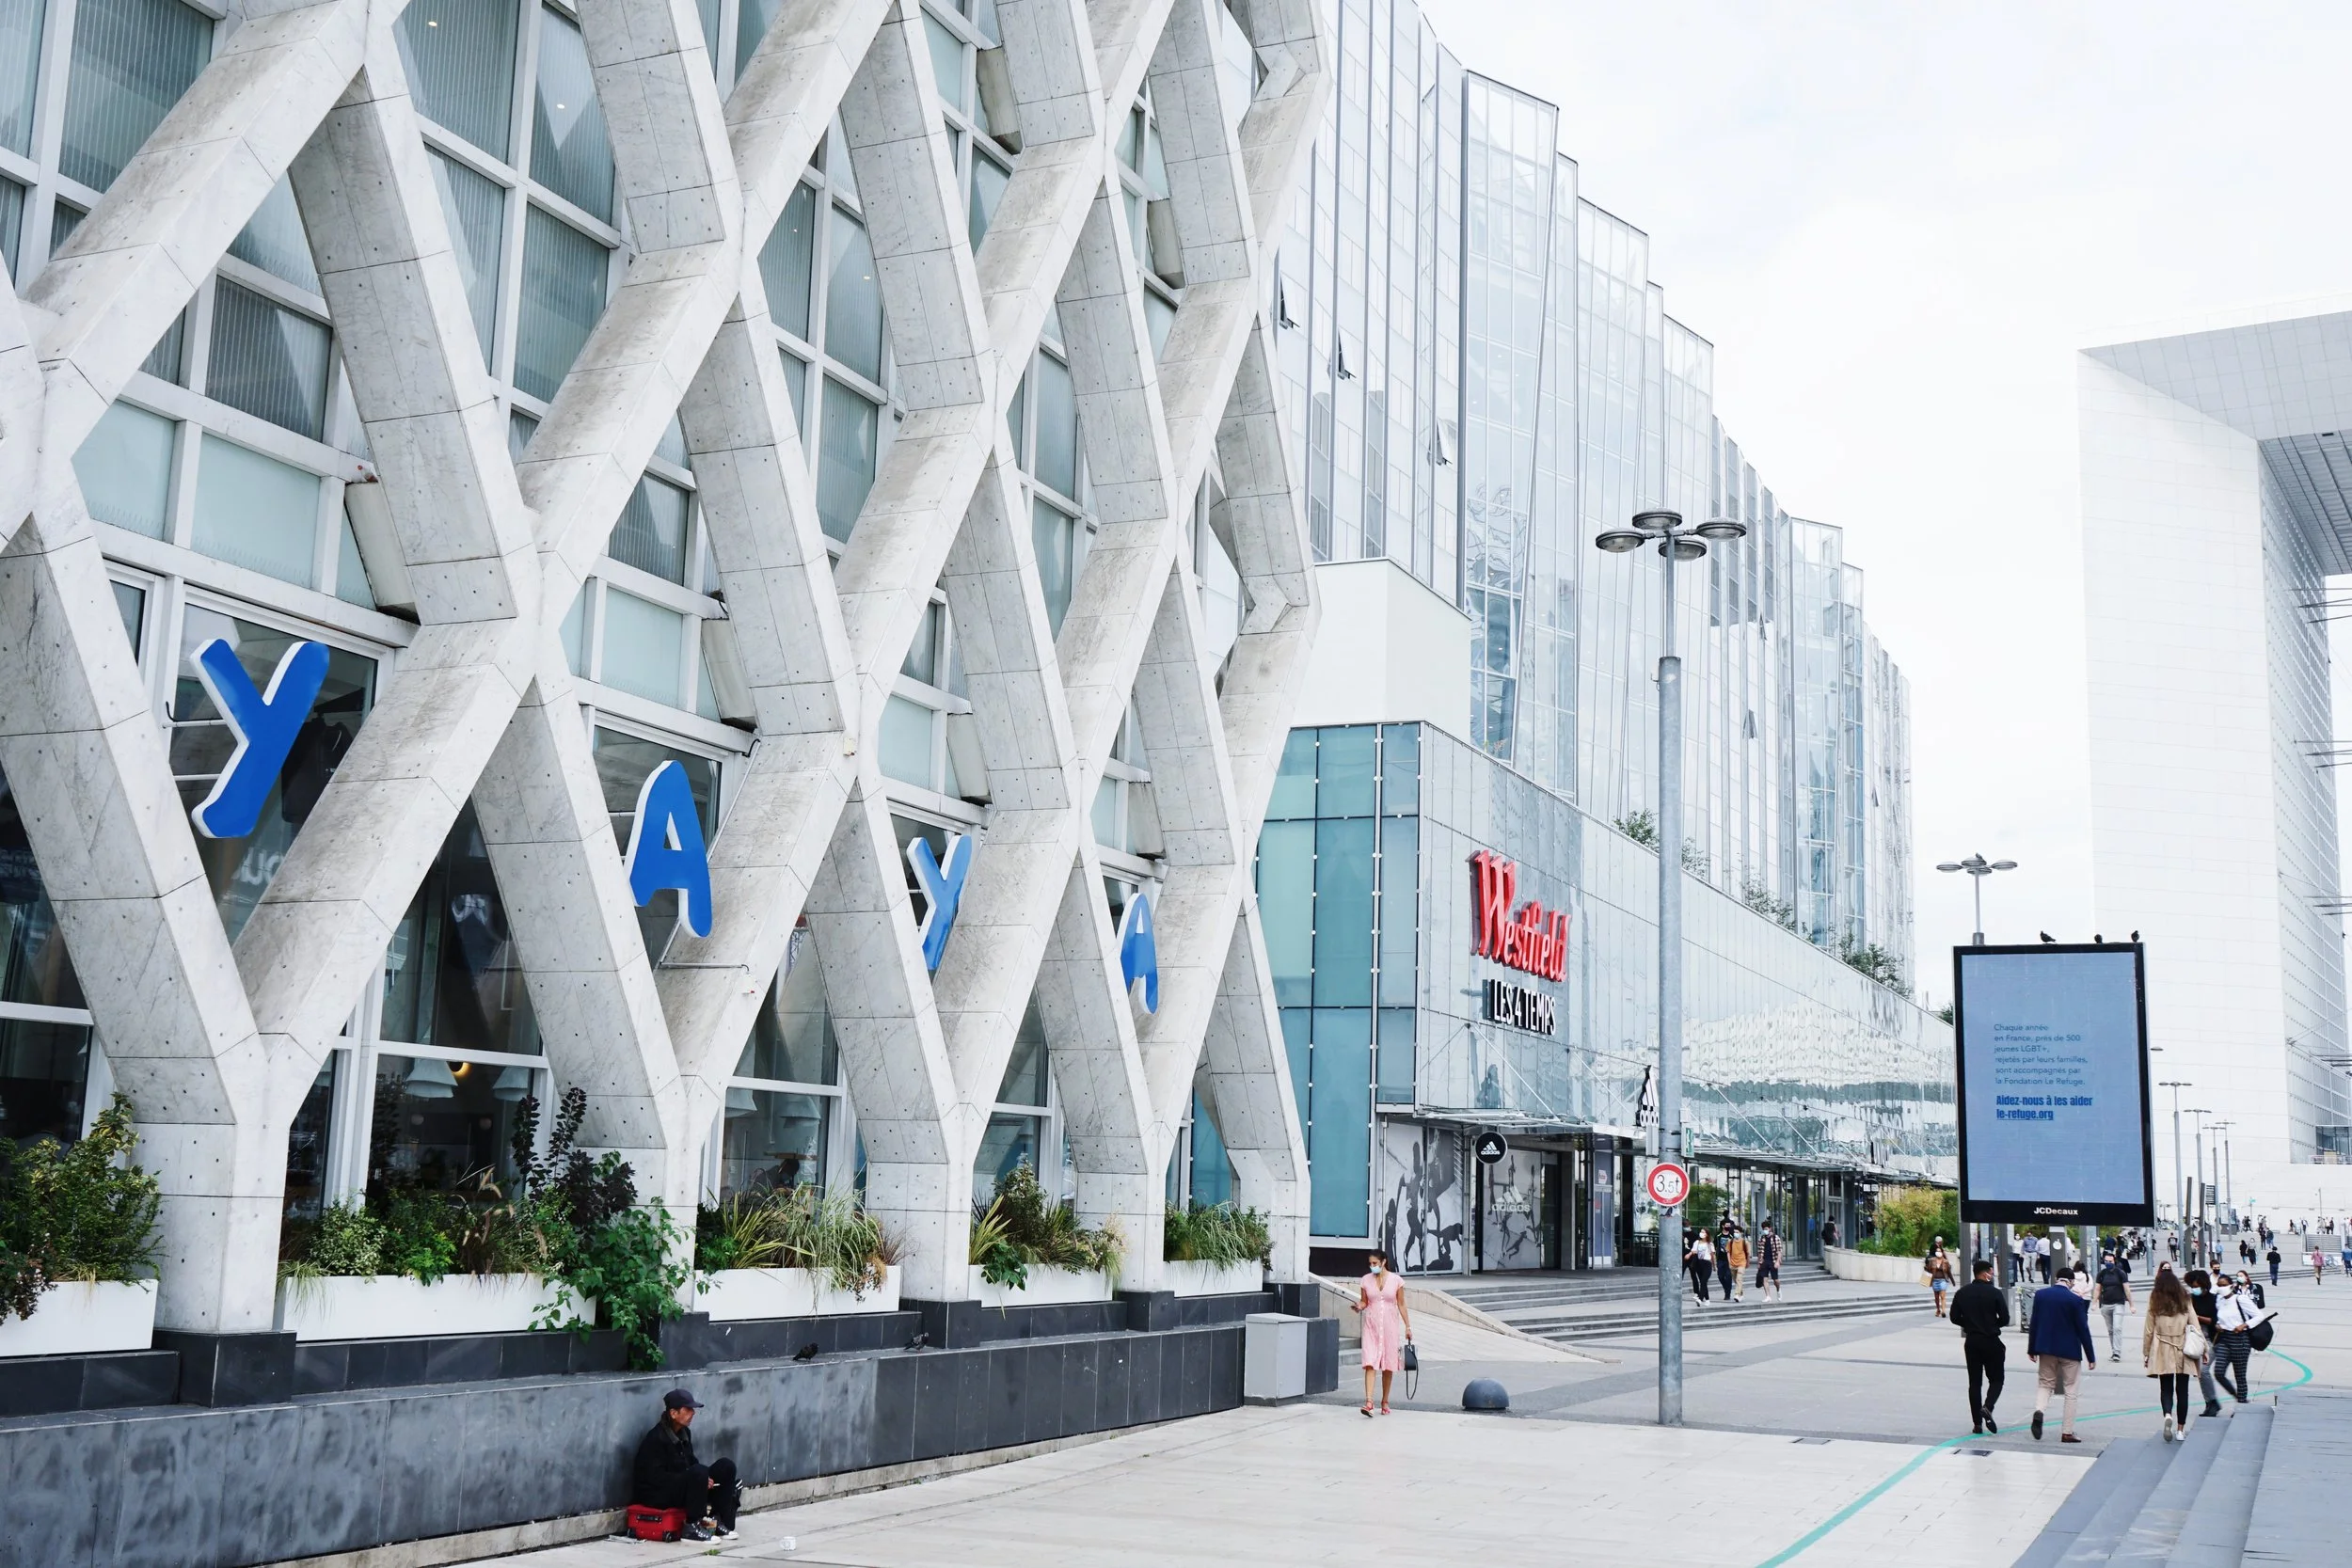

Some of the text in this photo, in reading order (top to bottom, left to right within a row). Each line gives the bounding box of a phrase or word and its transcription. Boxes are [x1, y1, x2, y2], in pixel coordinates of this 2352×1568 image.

[1474, 849, 1571, 983] Westfield
[1494, 978, 1557, 1036] LES 4 TEMPS
[1994, 1023, 2023, 1032] Chaque
[2057, 1055, 2088, 1064] familles,
[2013, 1067, 2066, 1075] accompagnés
[2056, 1078, 2086, 1086] Refuge.
[1995, 1094, 2093, 1106] Aidez-nous à les aider
[1996, 1108, 2054, 1120] le-refuge.org
[1491, 1202, 1532, 1212] adidas
[2033, 1207, 2078, 1215] JCDecaux
